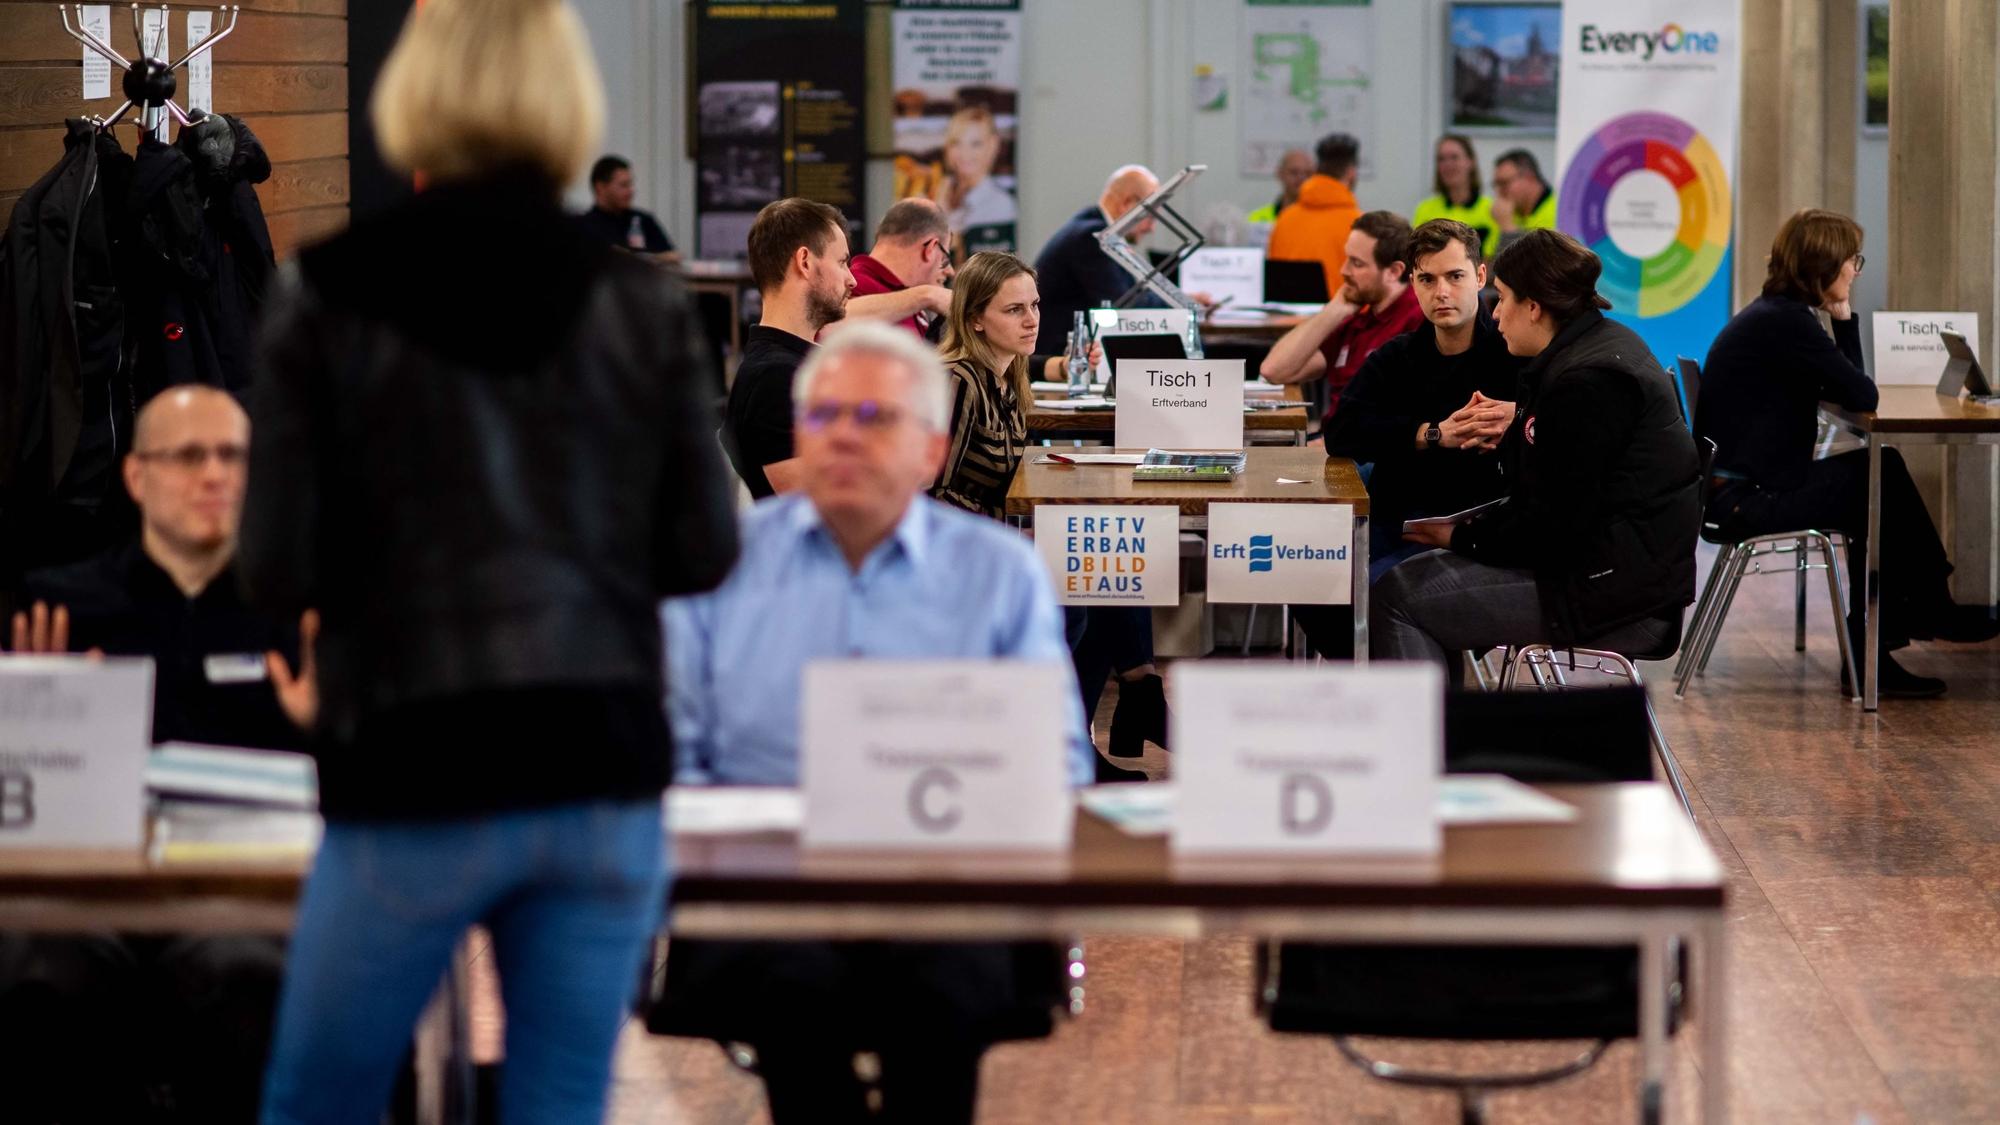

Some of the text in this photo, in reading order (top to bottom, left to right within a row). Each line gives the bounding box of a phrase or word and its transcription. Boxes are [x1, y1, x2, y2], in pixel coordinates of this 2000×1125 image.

[1580, 23, 1719, 61] EveryOne
[1117, 318, 1169, 331] Tisch 4
[1898, 320, 1939, 335] Tisch
[1146, 371, 1211, 387] Tisch 1
[1152, 398, 1208, 408] Erftverband
[1067, 517, 1145, 533] ERFTV
[1067, 537, 1145, 553] ERBAN
[1213, 544, 1347, 560] Erft Verband
[0, 769, 36, 829] B
[906, 767, 964, 834] C
[1279, 771, 1335, 837] D
